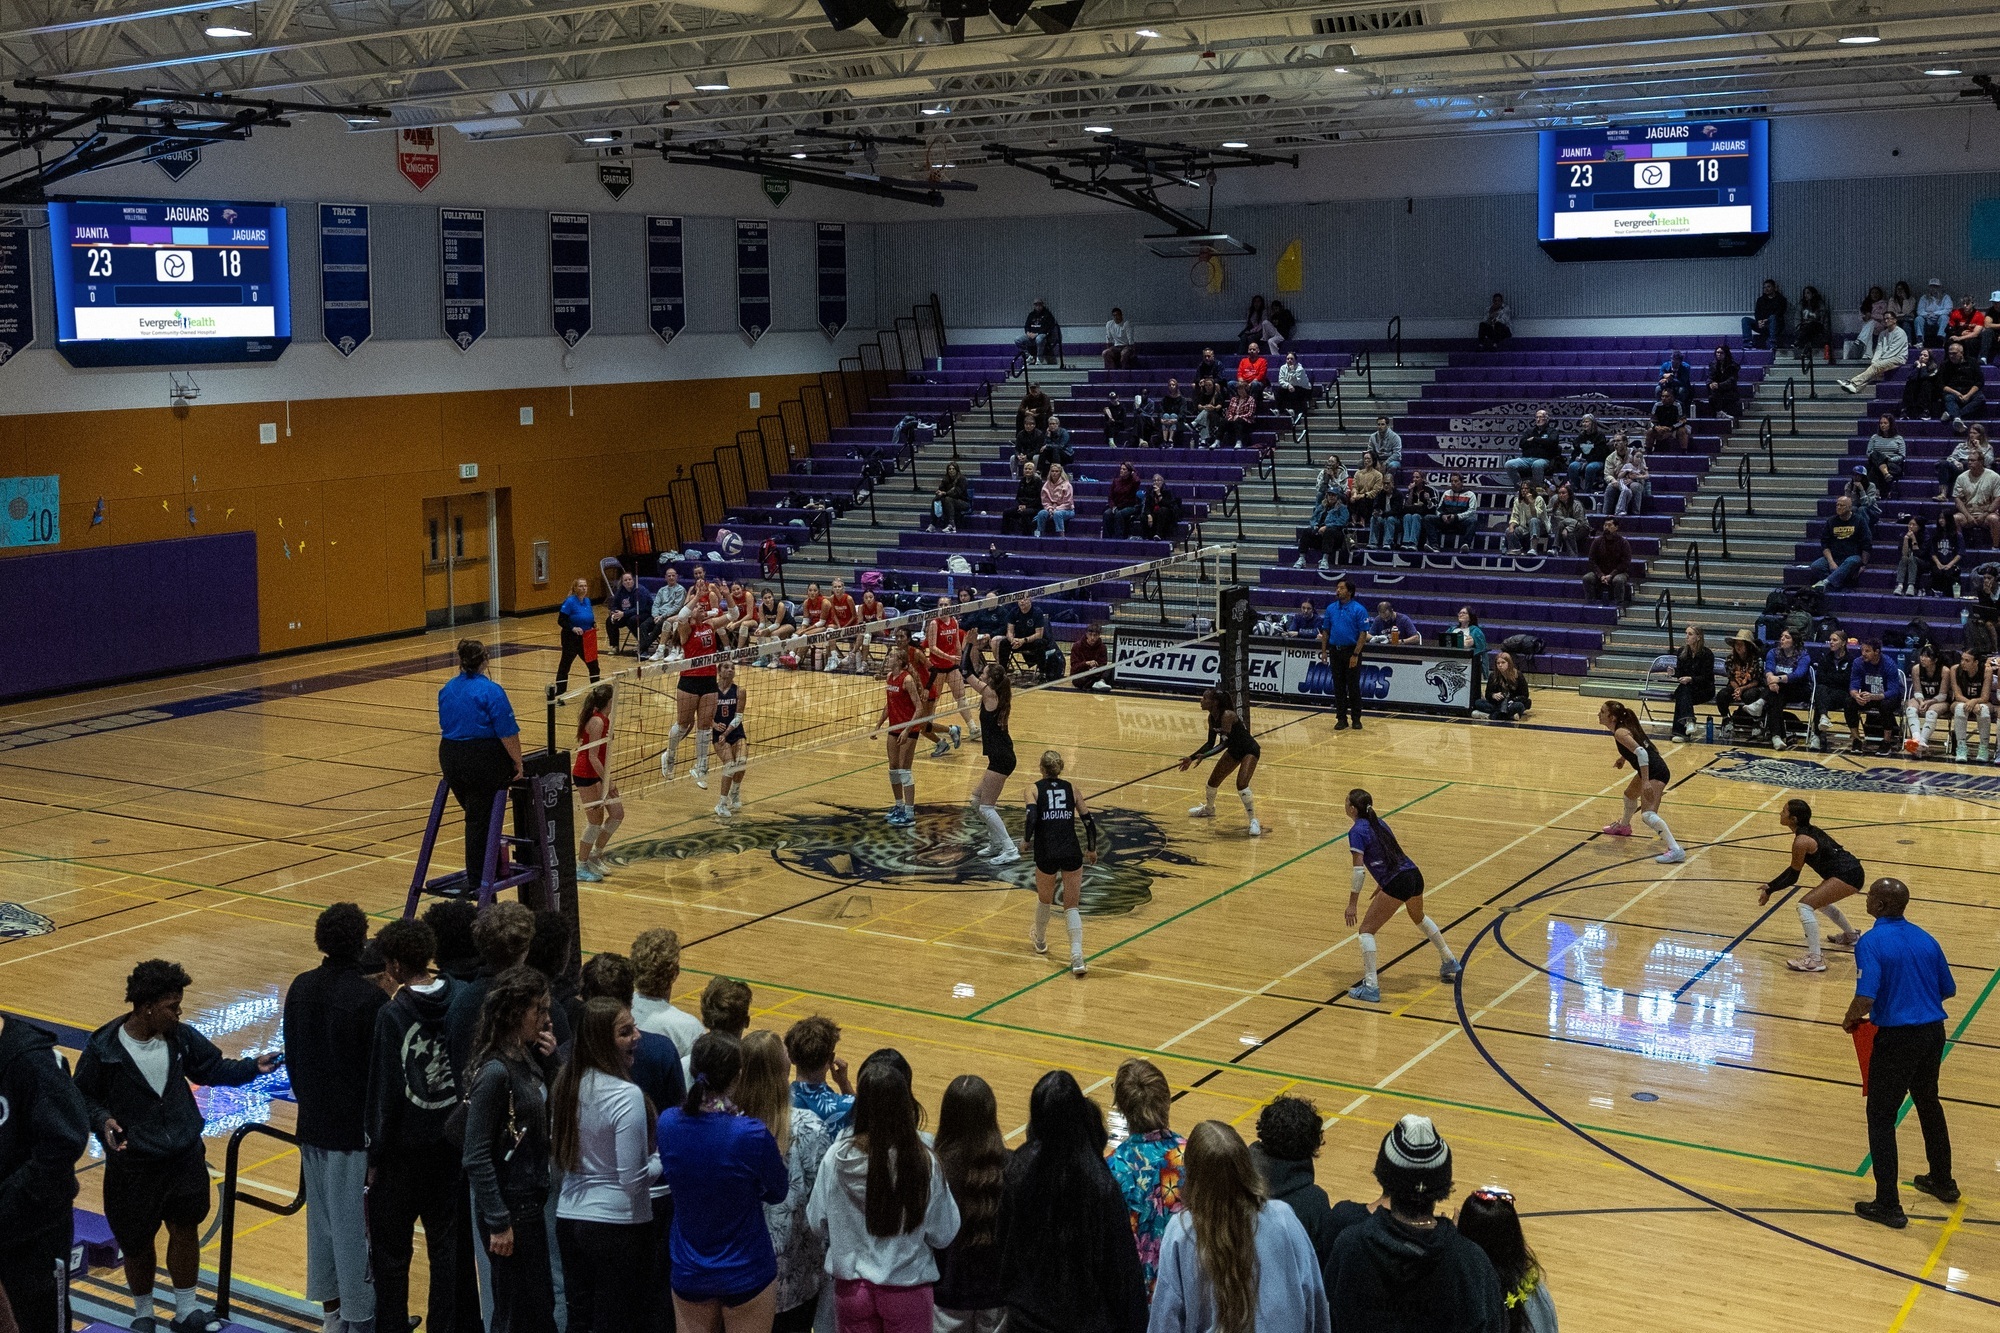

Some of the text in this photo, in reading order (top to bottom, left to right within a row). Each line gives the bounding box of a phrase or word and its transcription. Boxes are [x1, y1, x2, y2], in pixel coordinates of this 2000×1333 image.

[1645, 126, 1689, 140] JAGUARS
[1710, 140, 1746, 152] JAGUARS
[1561, 148, 1592, 158] JUANITA
[1570, 164, 1593, 188] 23
[1697, 159, 1719, 182] 18
[1729, 193, 1734, 202] 0
[1569, 200, 1575, 209] 0
[164, 207, 210, 222] JAGUARS
[332, 207, 356, 216] TRACK
[443, 212, 482, 220] VOLLEYBALL
[552, 215, 587, 224] WRESTLING
[1614, 217, 1690, 230] EvergreenHealth
[75, 227, 110, 239] JUANITA
[232, 229, 266, 241] JAGUARS
[87, 248, 113, 277] 23
[218, 250, 242, 277] 18
[90, 292, 96, 303] 0
[252, 291, 258, 302] 0
[138, 316, 216, 330] Evergreeealth
[1445, 456, 1498, 468] NORTH
[28, 508, 53, 542] 10
[924, 610, 939, 620] CREEK
[806, 625, 866, 645] NORTH CREEK JAGUARS
[701, 636, 713, 648] 15
[1120, 637, 1161, 650] WELCOME
[690, 647, 759, 669] NORTH CREEK JAGUARS
[1288, 650, 1315, 659] HOME
[1119, 650, 1282, 679] NORTH CEK
[1248, 681, 1280, 692] CHOOL
[1046, 789, 1067, 810] 12
[1041, 810, 1073, 821] JAGUARS
